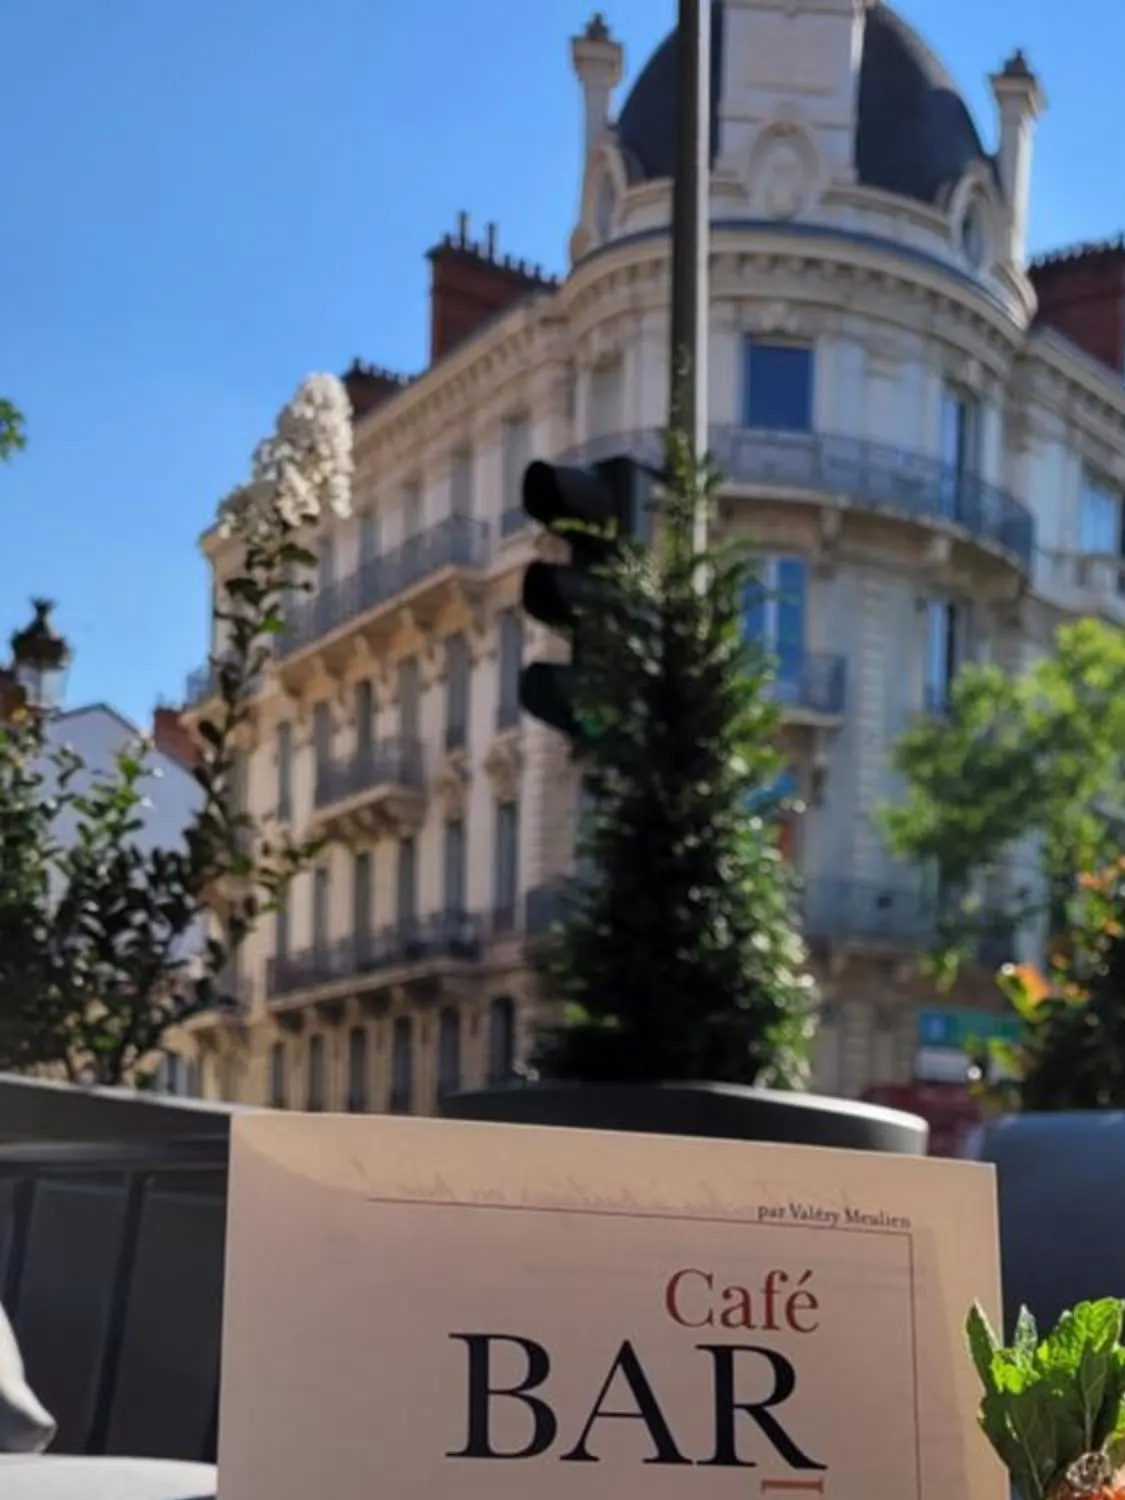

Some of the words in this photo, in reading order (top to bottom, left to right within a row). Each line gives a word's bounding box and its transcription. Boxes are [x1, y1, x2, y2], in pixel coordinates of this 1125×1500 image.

[757, 1205, 785, 1222] par
[665, 1268, 819, 1333] Café
[445, 1333, 828, 1470] BAR
